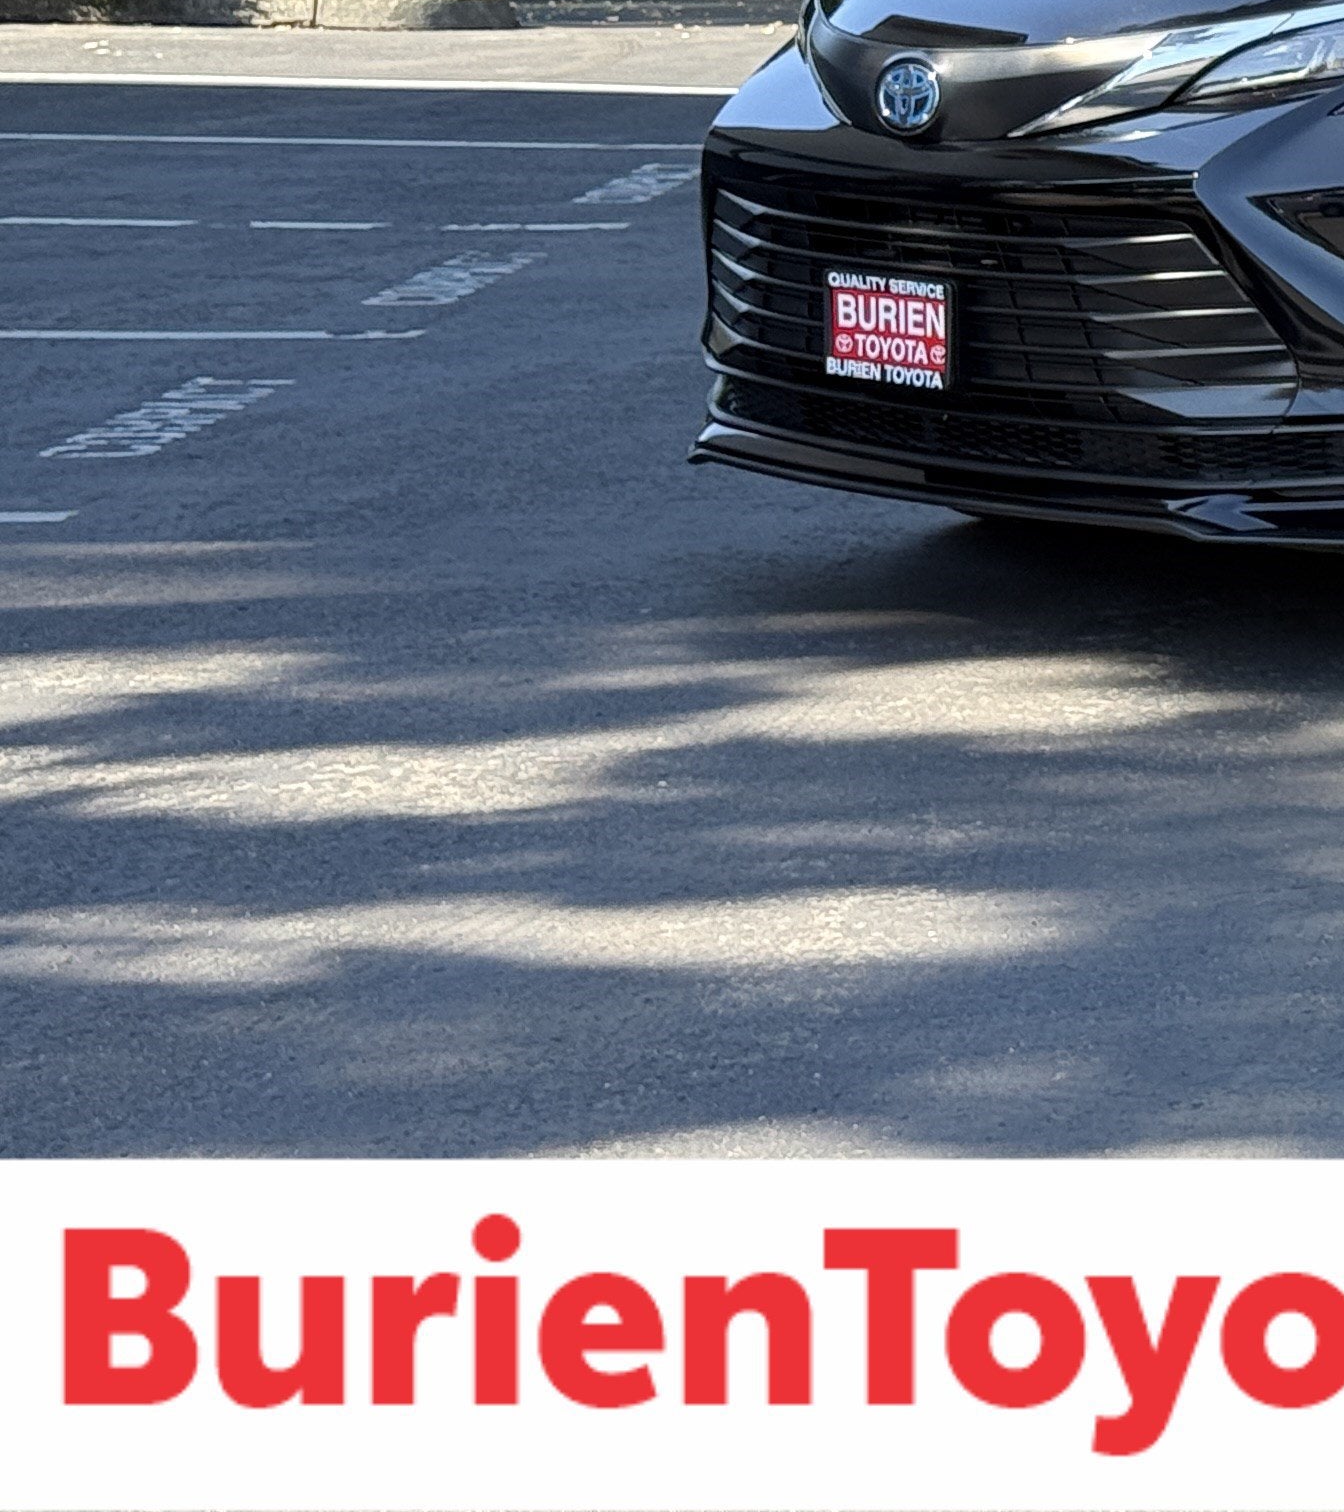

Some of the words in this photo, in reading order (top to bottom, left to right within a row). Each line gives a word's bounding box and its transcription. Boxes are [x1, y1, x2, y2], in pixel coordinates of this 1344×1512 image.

[828, 272, 886, 291] QUALITY
[889, 278, 945, 300] SERVICE
[837, 293, 945, 339] BURIEN
[854, 334, 928, 365] TOYOTA
[826, 357, 881, 381] BURIEN
[884, 365, 943, 390] TOYOTA
